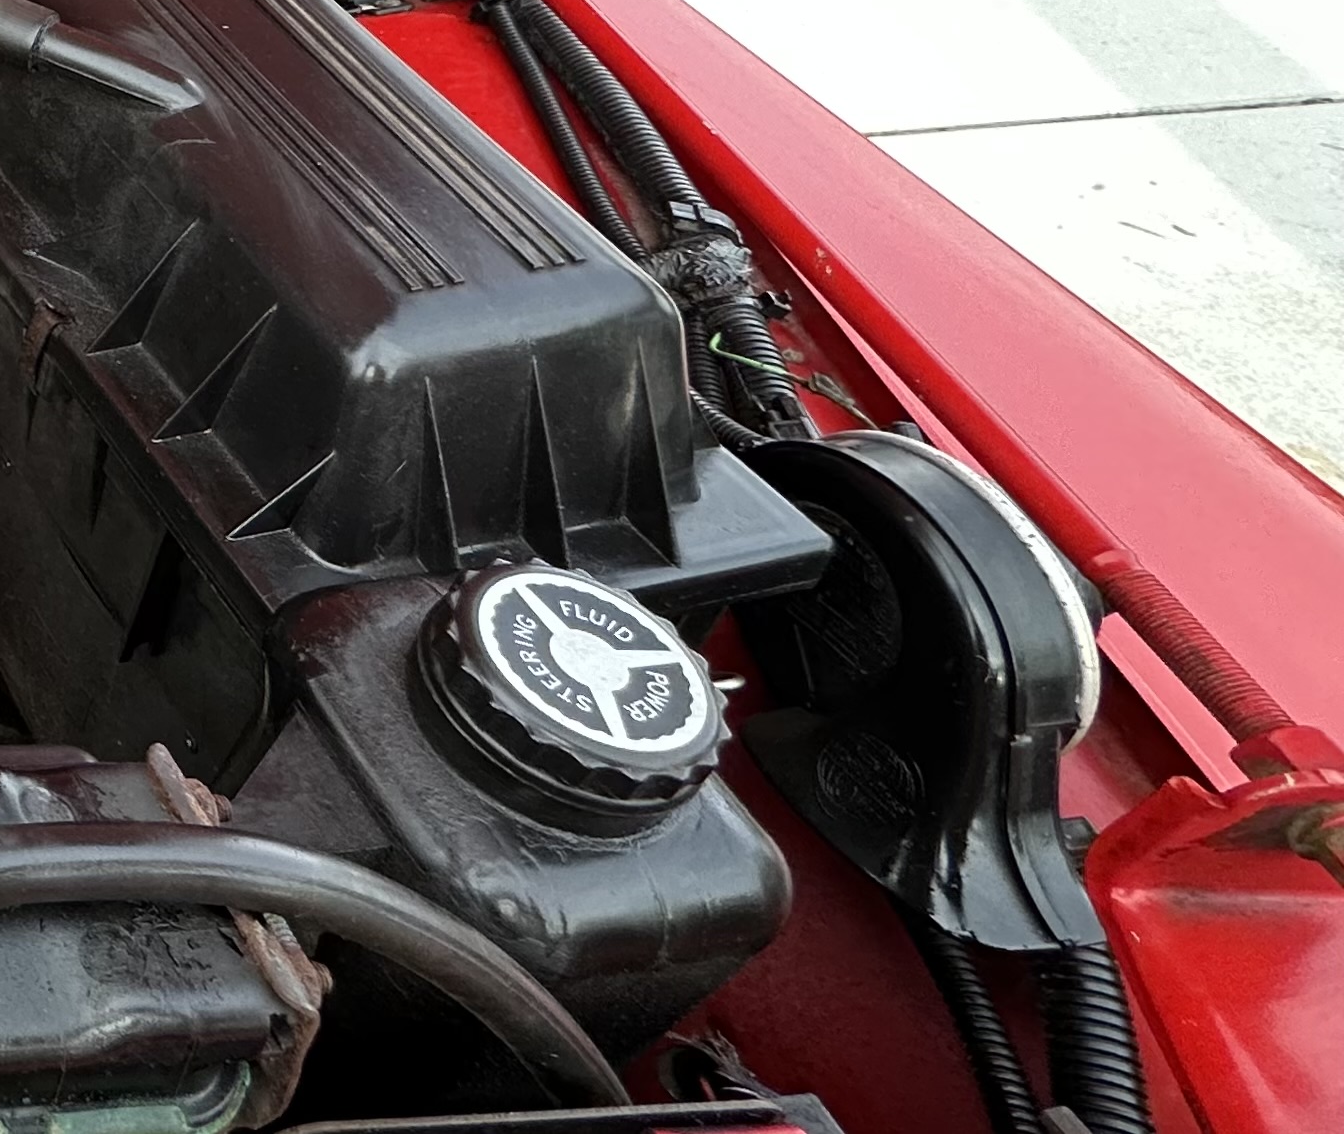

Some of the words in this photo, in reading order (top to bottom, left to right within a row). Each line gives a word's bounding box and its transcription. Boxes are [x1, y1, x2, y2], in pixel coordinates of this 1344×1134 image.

[559, 599, 633, 644] FLUID
[513, 613, 594, 714] STEERING
[622, 670, 670, 722] POWER
